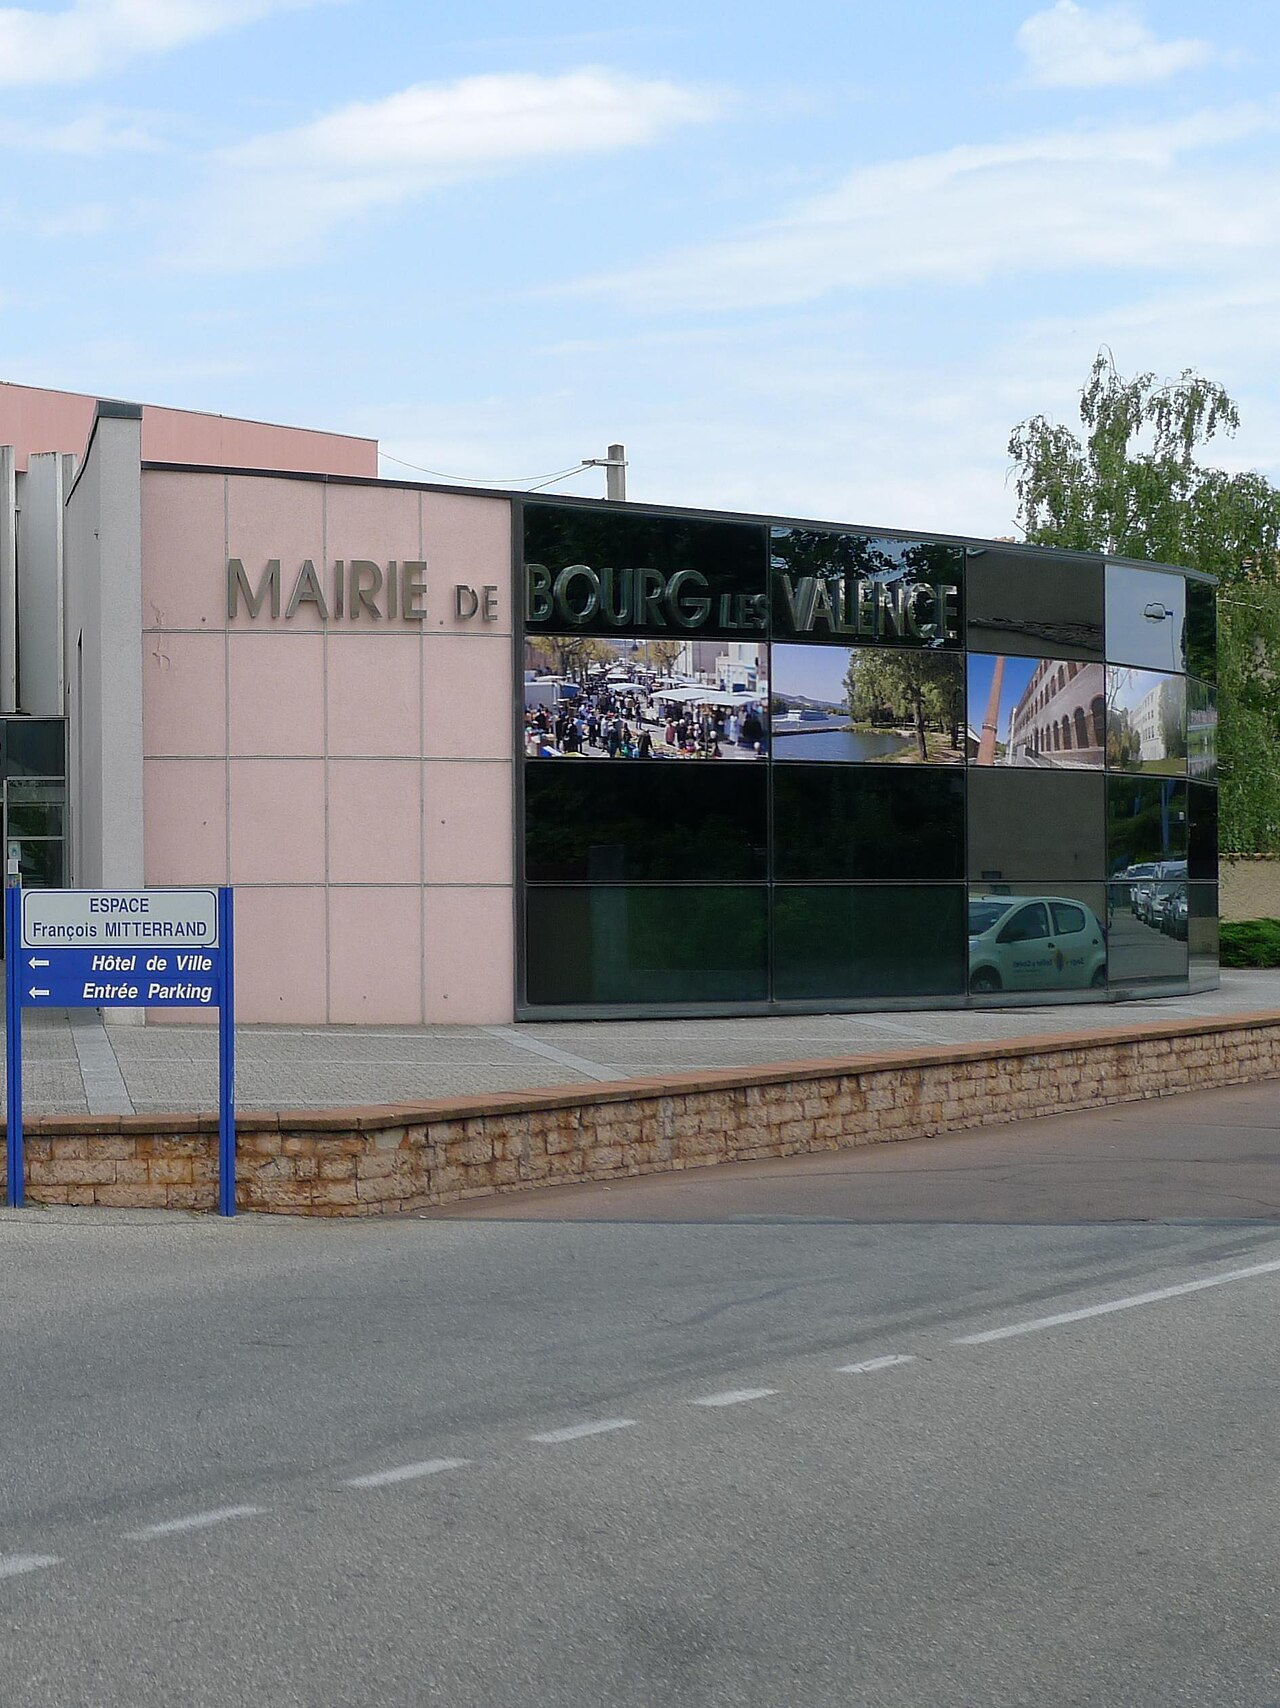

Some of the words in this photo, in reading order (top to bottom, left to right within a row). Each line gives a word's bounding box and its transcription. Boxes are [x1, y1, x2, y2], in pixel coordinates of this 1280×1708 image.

[227, 558, 427, 619] MAIRIE
[454, 584, 498, 621] DE
[526, 563, 712, 628] BOURG
[720, 593, 770, 630] LES
[776, 574, 958, 639] VALENCE
[90, 898, 149, 913] ESPACE
[33, 922, 97, 941] François
[105, 921, 207, 937] MITTERRAND
[91, 955, 136, 971] Hôtel
[146, 955, 167, 971] de
[176, 955, 212, 971] Ville
[82, 982, 138, 999] Entrée
[148, 983, 212, 1002] Parking
